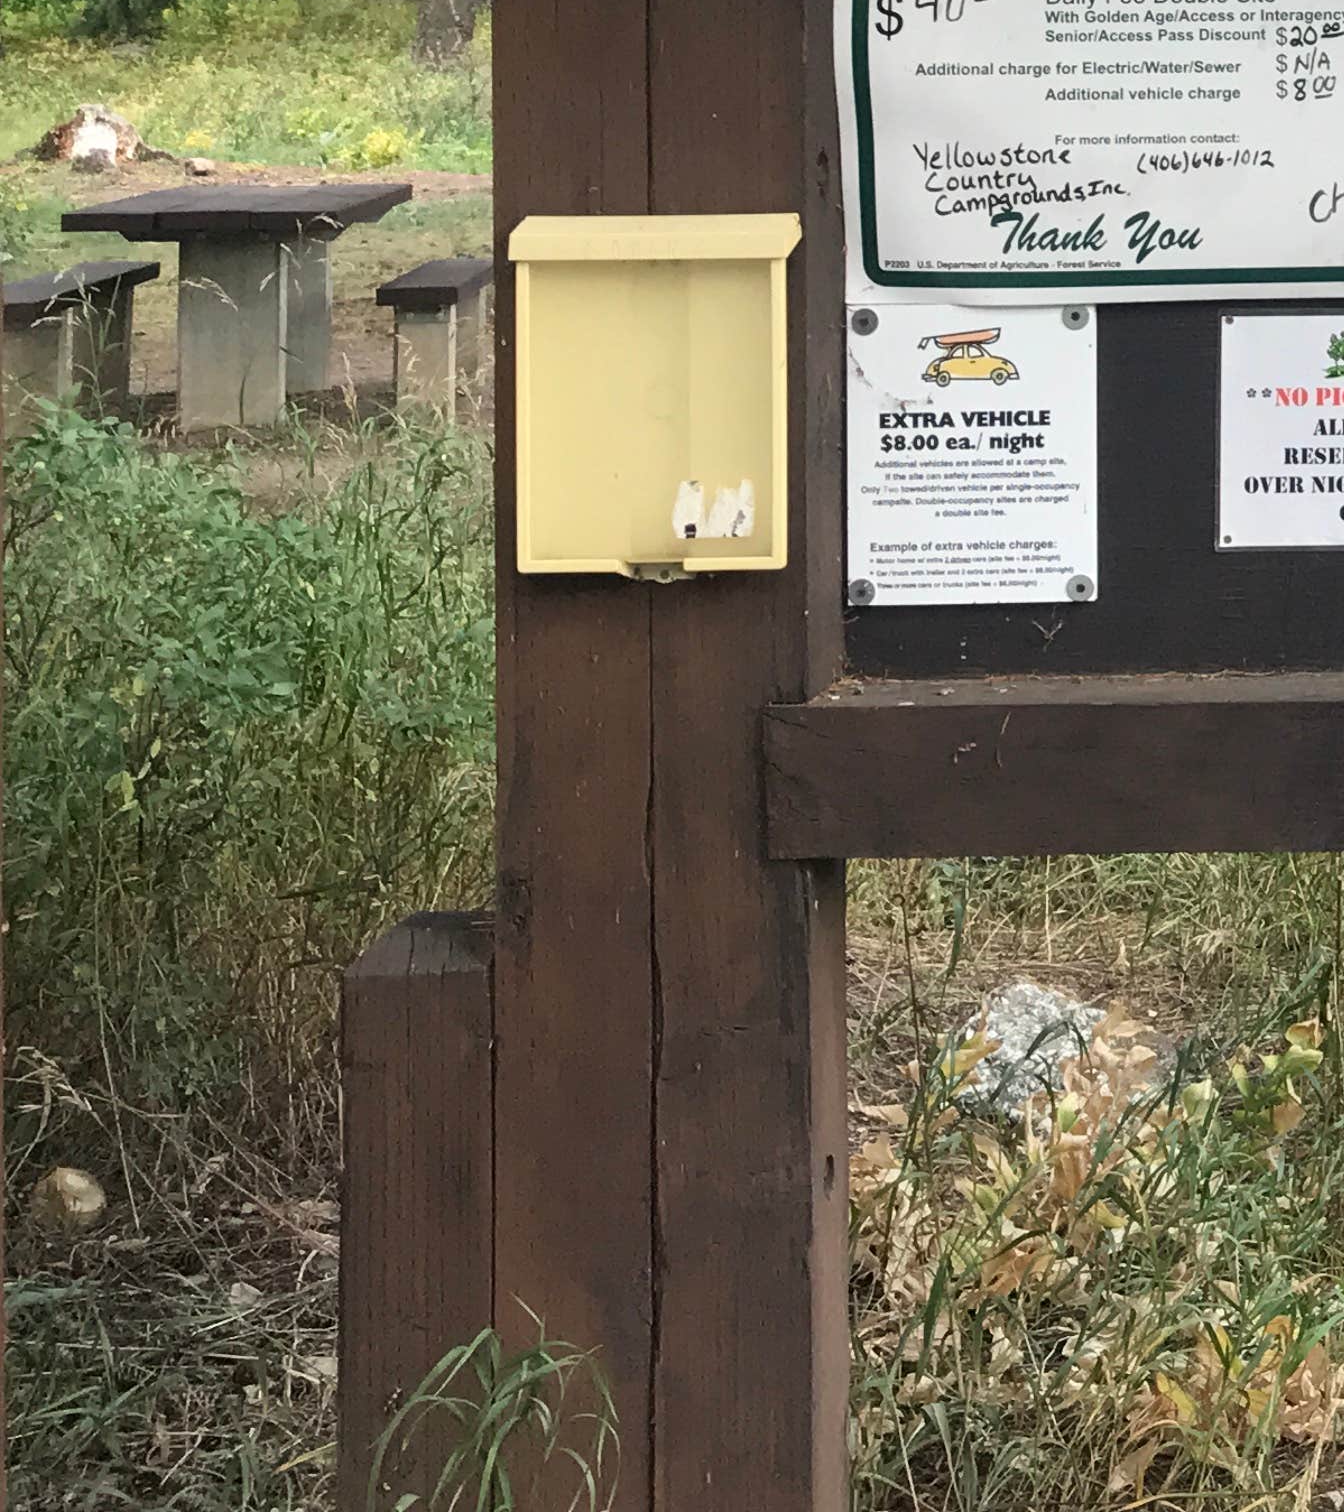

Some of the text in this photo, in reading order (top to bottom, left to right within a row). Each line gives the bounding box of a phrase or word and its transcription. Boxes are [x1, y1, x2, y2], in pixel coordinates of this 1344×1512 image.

[915, 61, 1241, 78] Additional charge for Electric/Water/Sewer
[1055, 135, 1076, 145] For
[1079, 137, 1111, 145] more
[1115, 134, 1186, 144] information
[913, 142, 1073, 170] Yellowstone
[1136, 149, 1275, 175] (406)646-1012
[925, 170, 1037, 193] Country
[990, 210, 1203, 264] Thank You
[880, 410, 1050, 428] EXTRA VEHICLE
[881, 434, 939, 453] $8.00
[990, 433, 1044, 454] night
[1245, 477, 1303, 493] OVER
